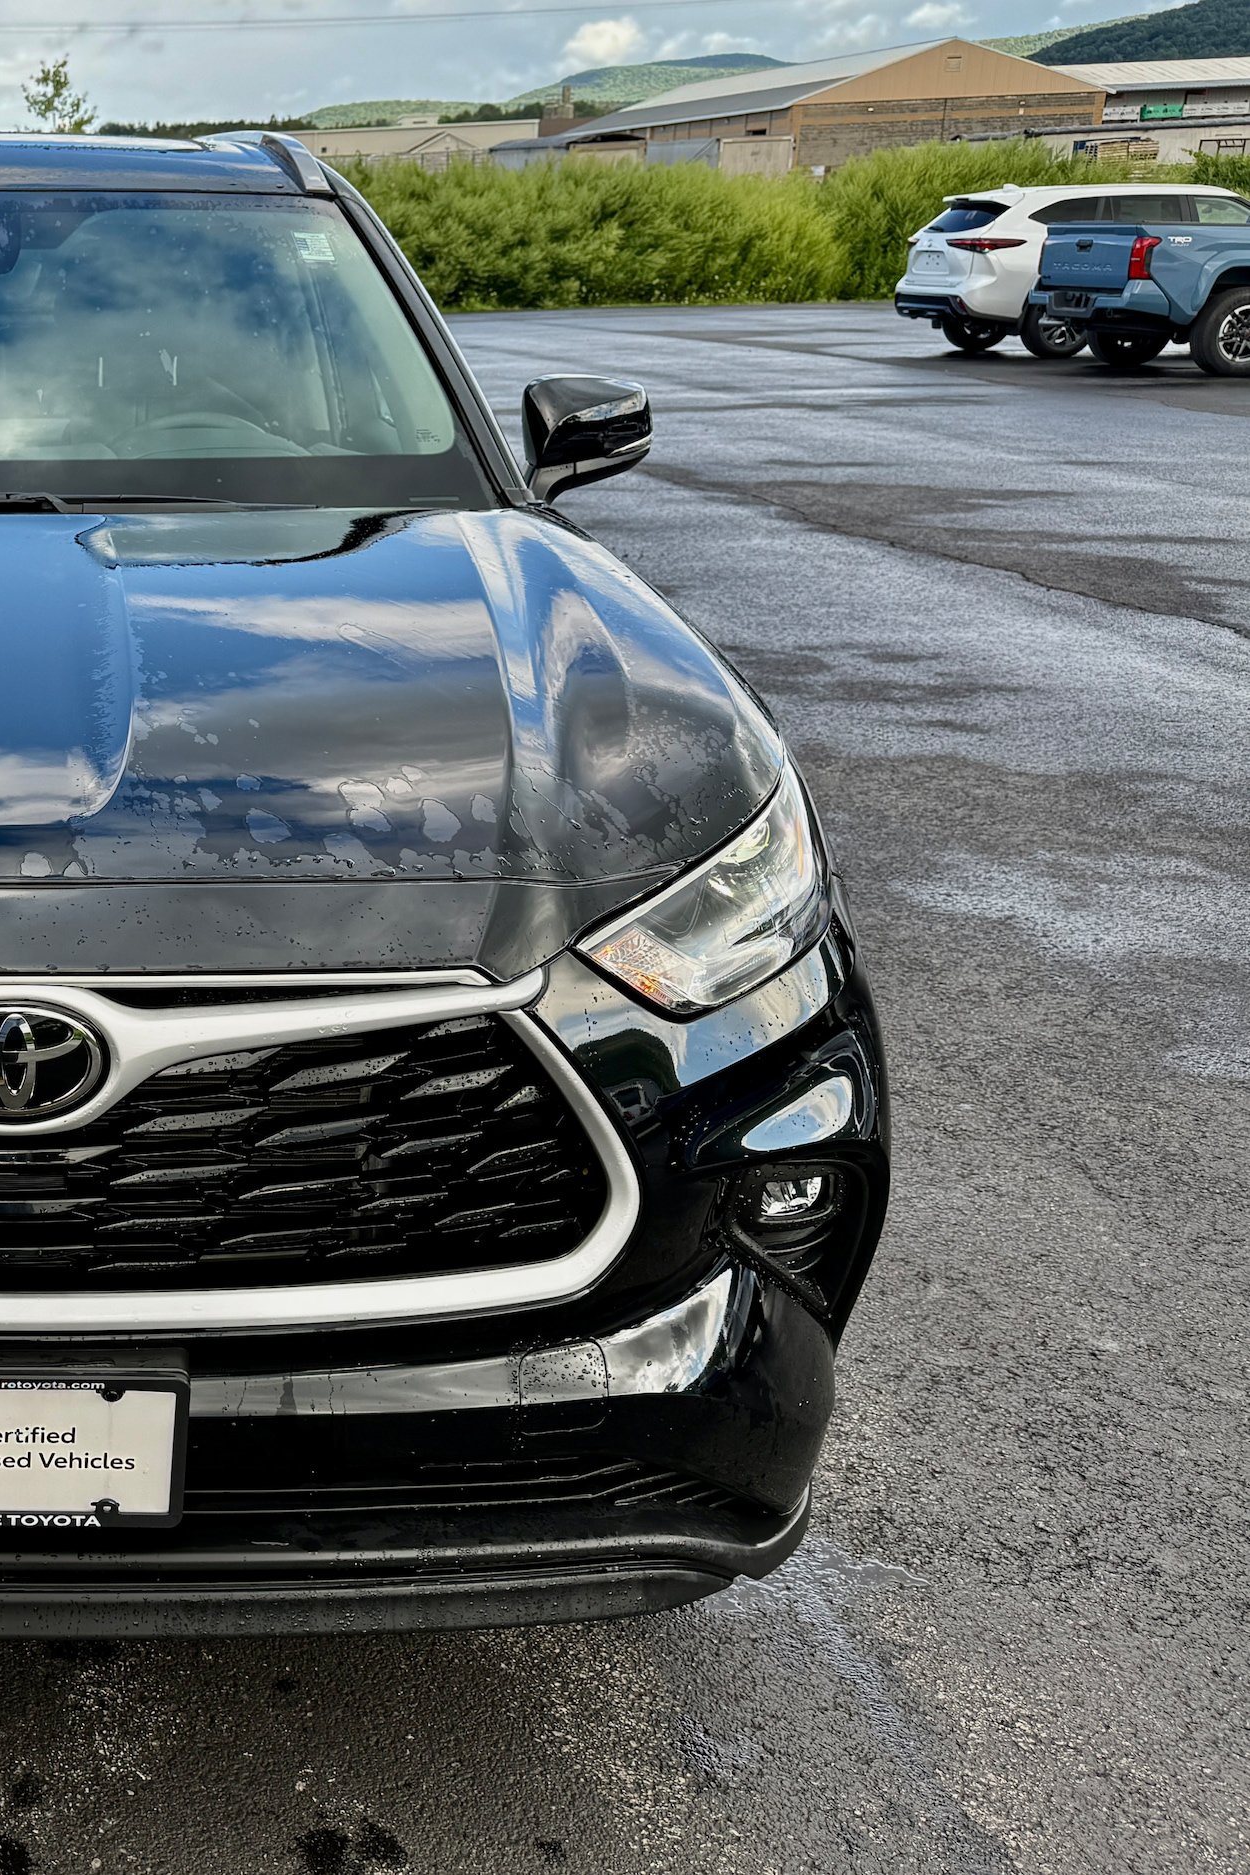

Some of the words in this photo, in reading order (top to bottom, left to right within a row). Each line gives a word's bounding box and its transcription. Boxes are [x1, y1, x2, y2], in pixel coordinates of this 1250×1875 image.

[1053, 262, 1113, 271] TACOMA
[38, 1452, 135, 1470] Vehicles
[6, 1514, 102, 1527] TOYOTA
